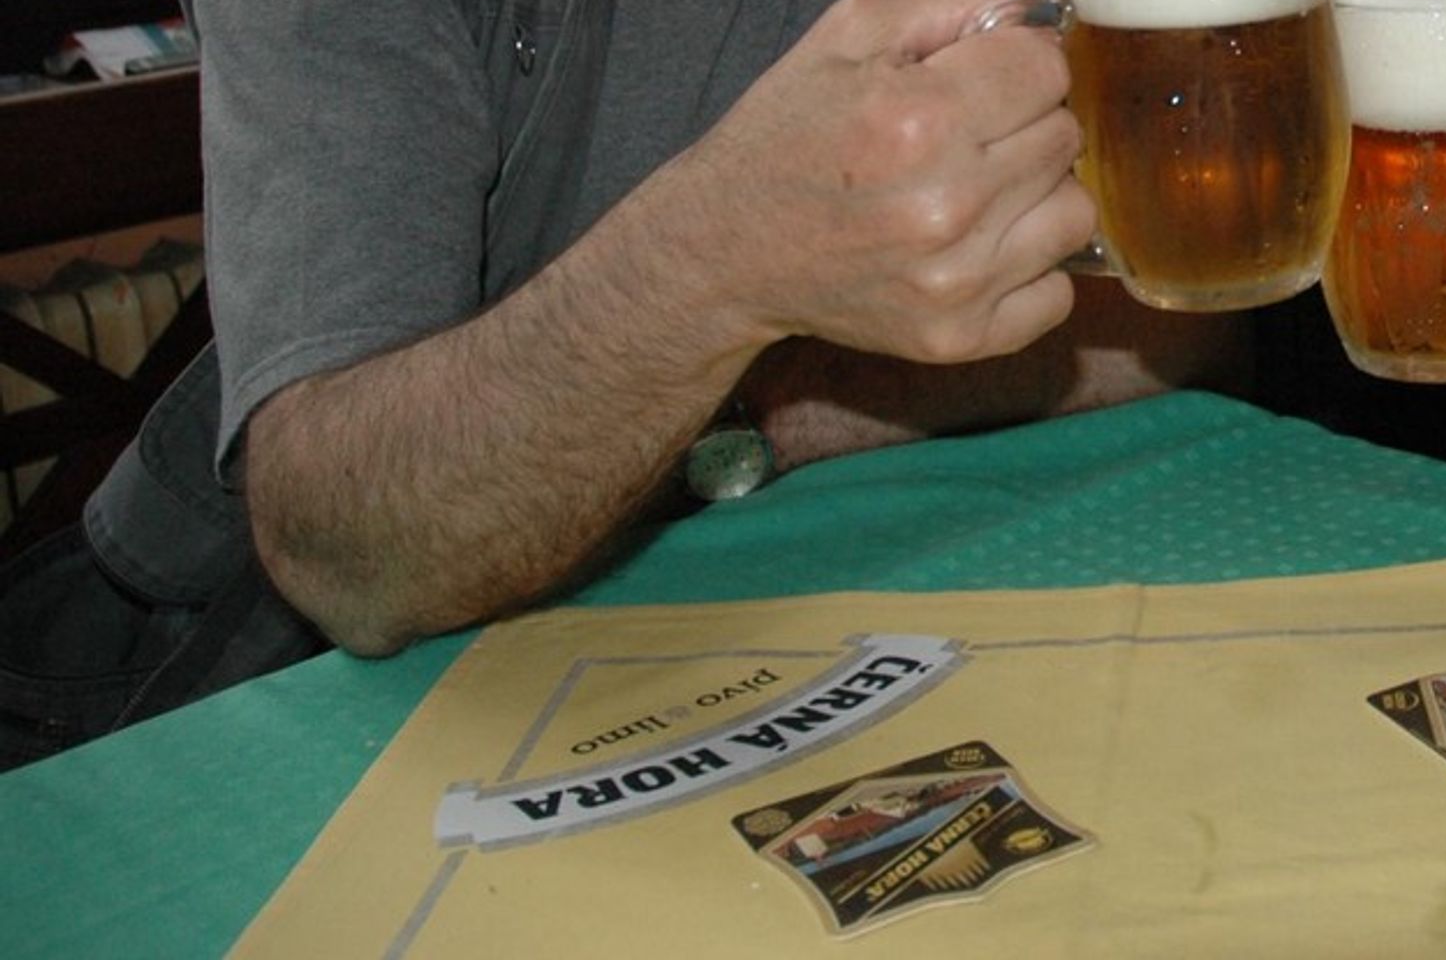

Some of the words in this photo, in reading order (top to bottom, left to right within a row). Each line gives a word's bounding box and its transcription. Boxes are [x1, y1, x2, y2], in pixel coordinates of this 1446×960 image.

[696, 668, 781, 707] pivo
[726, 655, 932, 753] ČERNÁ
[571, 713, 670, 756] limo
[512, 750, 731, 820] HORA
[865, 849, 930, 902] HORA
